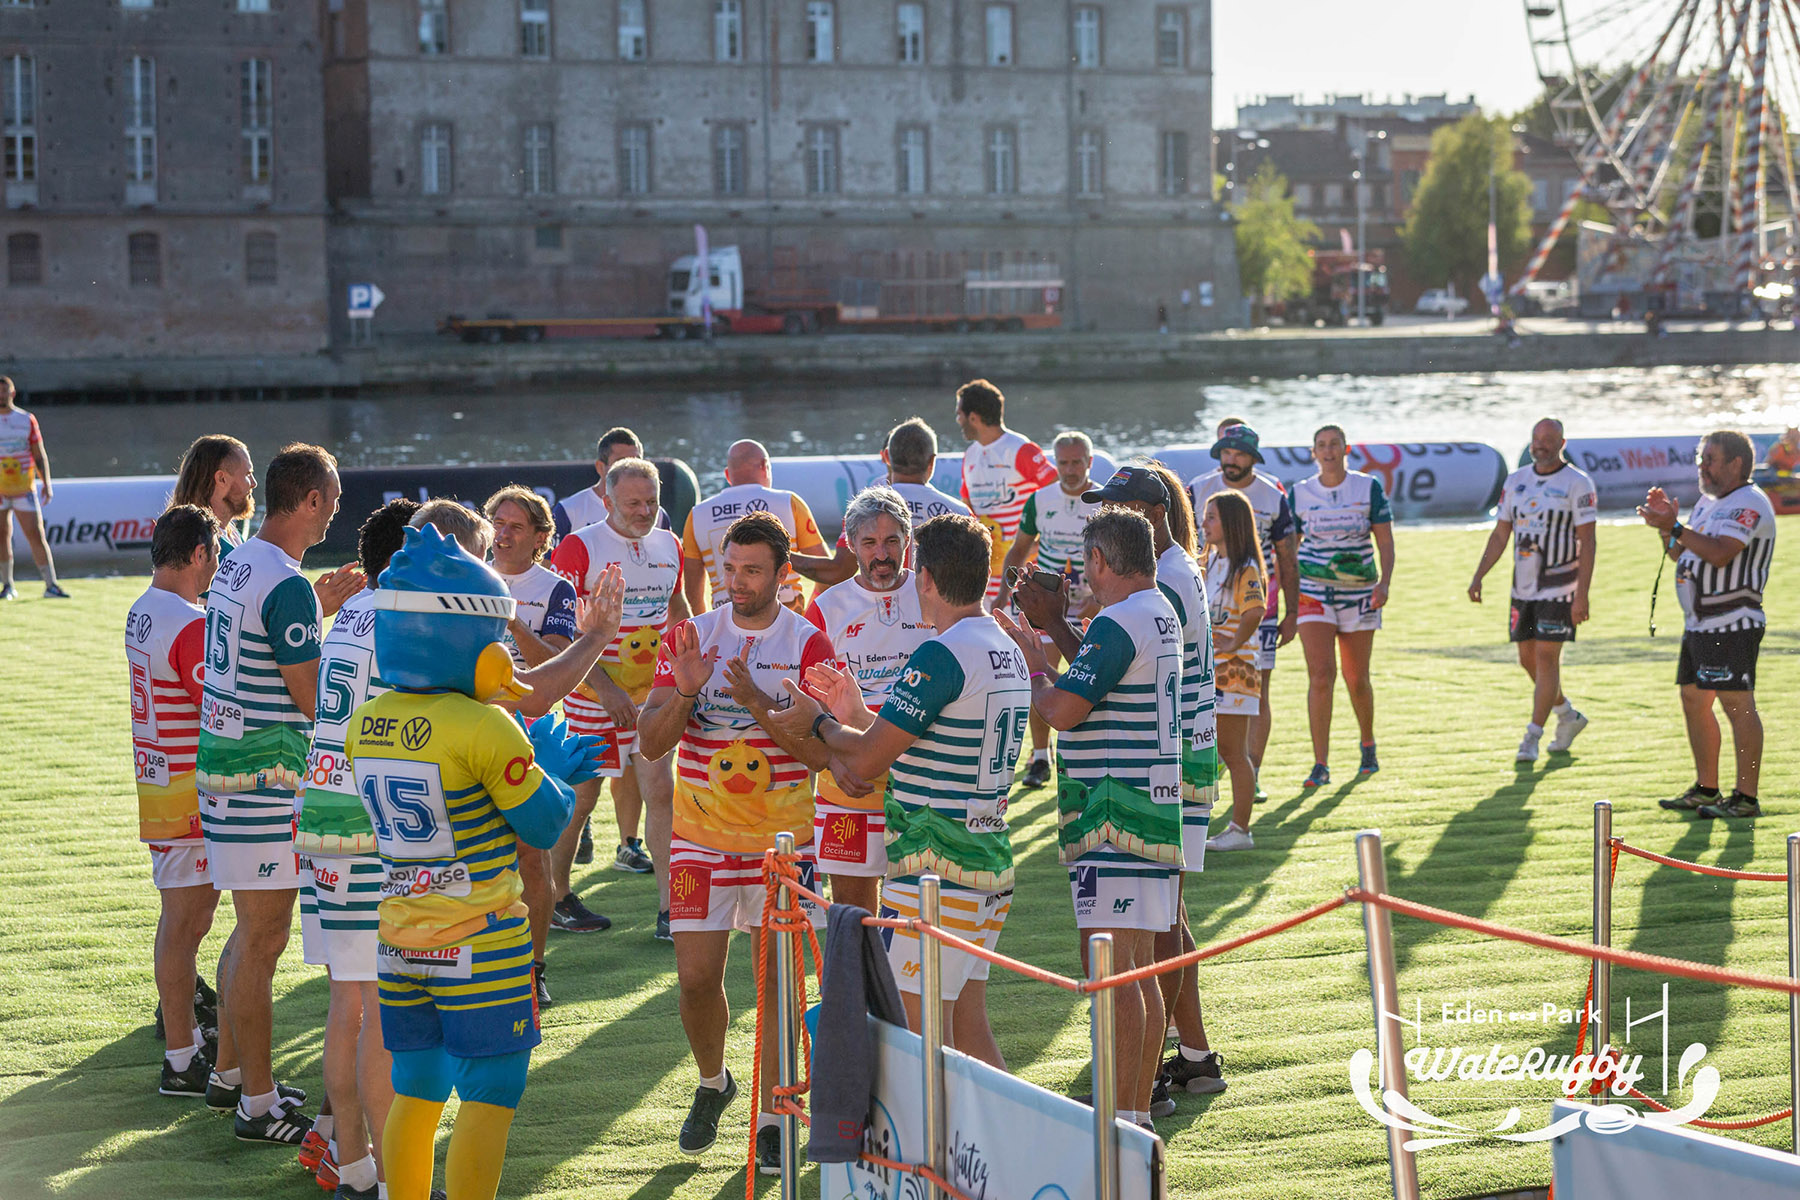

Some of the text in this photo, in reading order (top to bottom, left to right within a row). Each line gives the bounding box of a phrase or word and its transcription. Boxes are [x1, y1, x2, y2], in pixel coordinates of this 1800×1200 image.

[351, 287, 369, 309] P
[1582, 452, 1621, 472] Das
[712, 503, 742, 518] DBF
[546, 615, 577, 632] Remp
[847, 622, 866, 638] MF
[756, 662, 771, 670] Das
[866, 654, 887, 663] Eden
[901, 666, 922, 688] 90
[361, 716, 399, 738] DBF
[362, 774, 439, 843] 15
[824, 846, 862, 858] Occitanie
[258, 862, 280, 878] MF
[389, 867, 465, 888] toulouse
[1112, 898, 1135, 914] MF
[513, 1018, 529, 1038] MF
